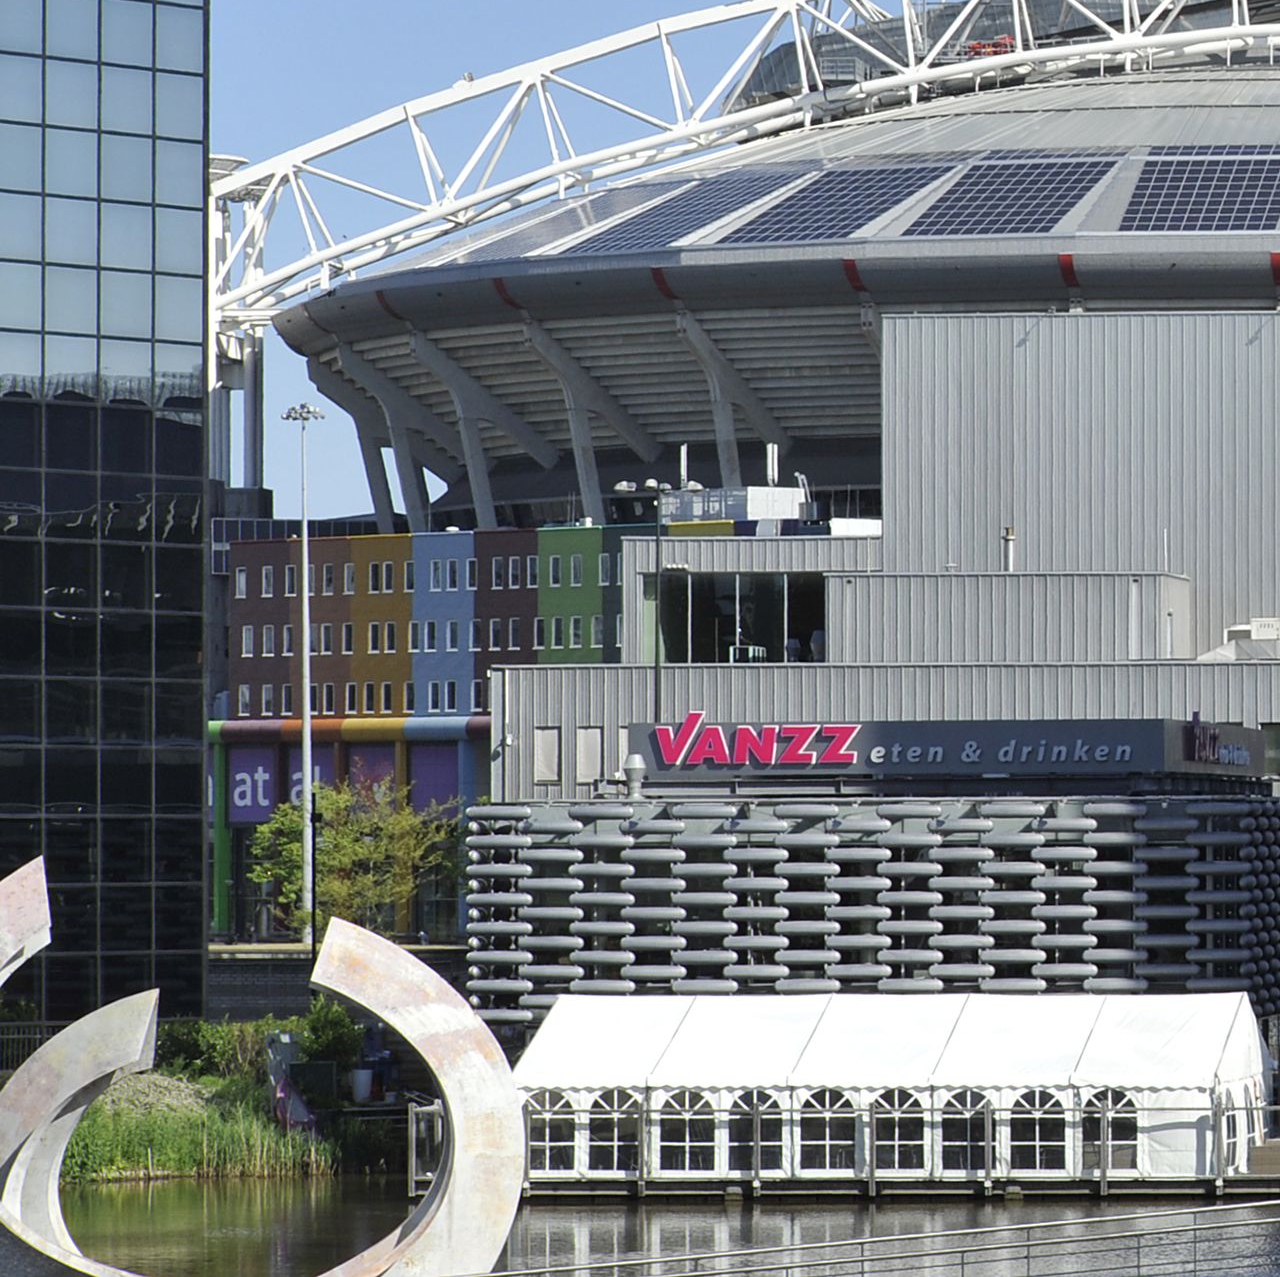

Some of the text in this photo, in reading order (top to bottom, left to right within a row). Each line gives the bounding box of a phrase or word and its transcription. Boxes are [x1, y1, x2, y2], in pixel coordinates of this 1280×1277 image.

[655, 710, 1132, 765] VANZZ eten & drinken
[233, 766, 270, 807] at
